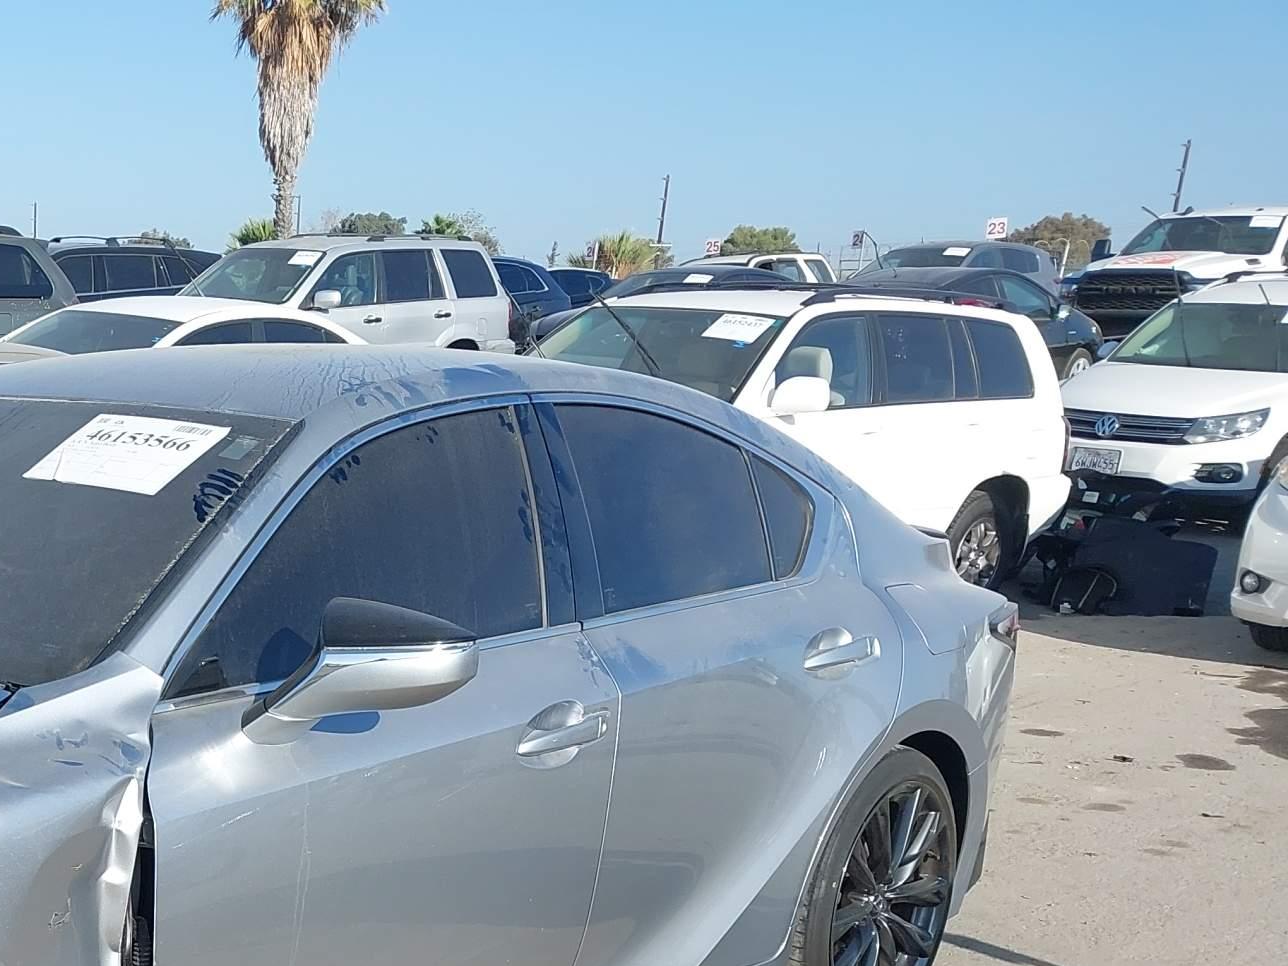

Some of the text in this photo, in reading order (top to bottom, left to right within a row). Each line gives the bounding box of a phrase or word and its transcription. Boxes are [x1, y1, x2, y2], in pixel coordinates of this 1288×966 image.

[988, 222, 1006, 235] 23
[706, 241, 720, 252] 25
[86, 428, 198, 451] 46153566
